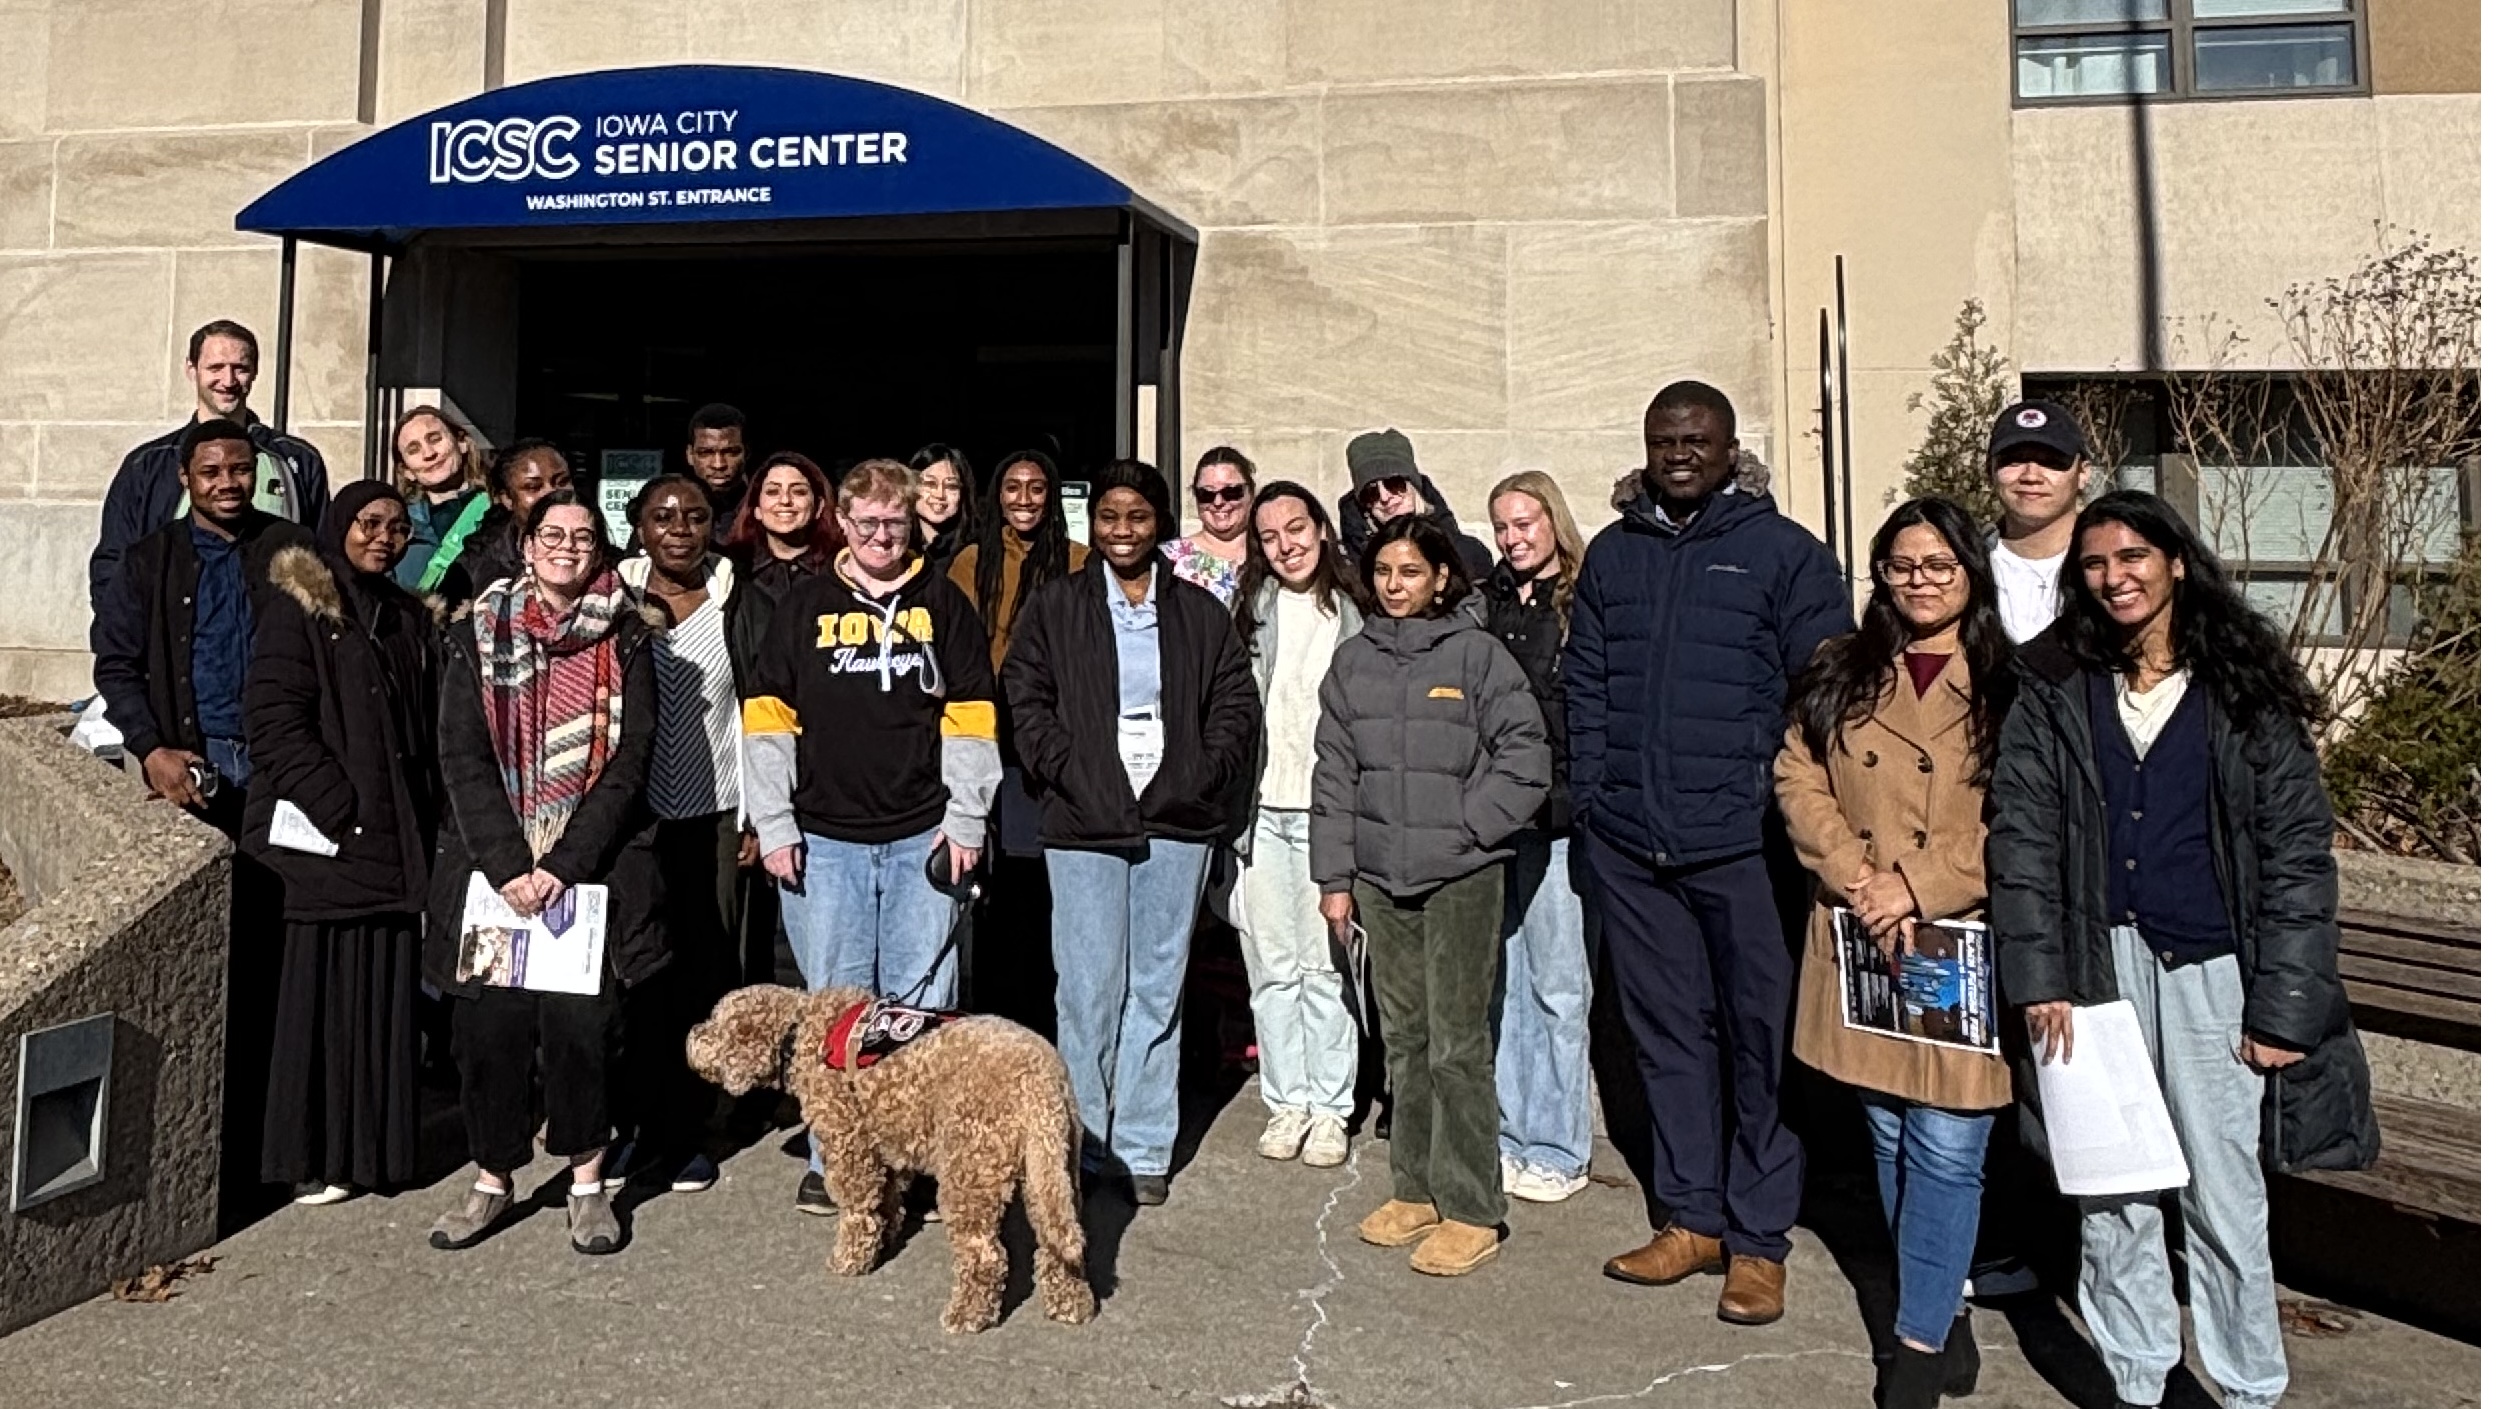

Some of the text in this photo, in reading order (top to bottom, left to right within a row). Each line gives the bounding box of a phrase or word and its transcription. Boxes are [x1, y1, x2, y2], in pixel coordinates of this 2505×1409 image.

[596, 109, 739, 138] IOWA CITY
[430, 114, 581, 184] ICSC
[594, 131, 907, 175] SENIOR CENTER
[526, 187, 771, 210] WASHINGTON ST. ENTRANCE
[828, 646, 925, 676] Haweyes
